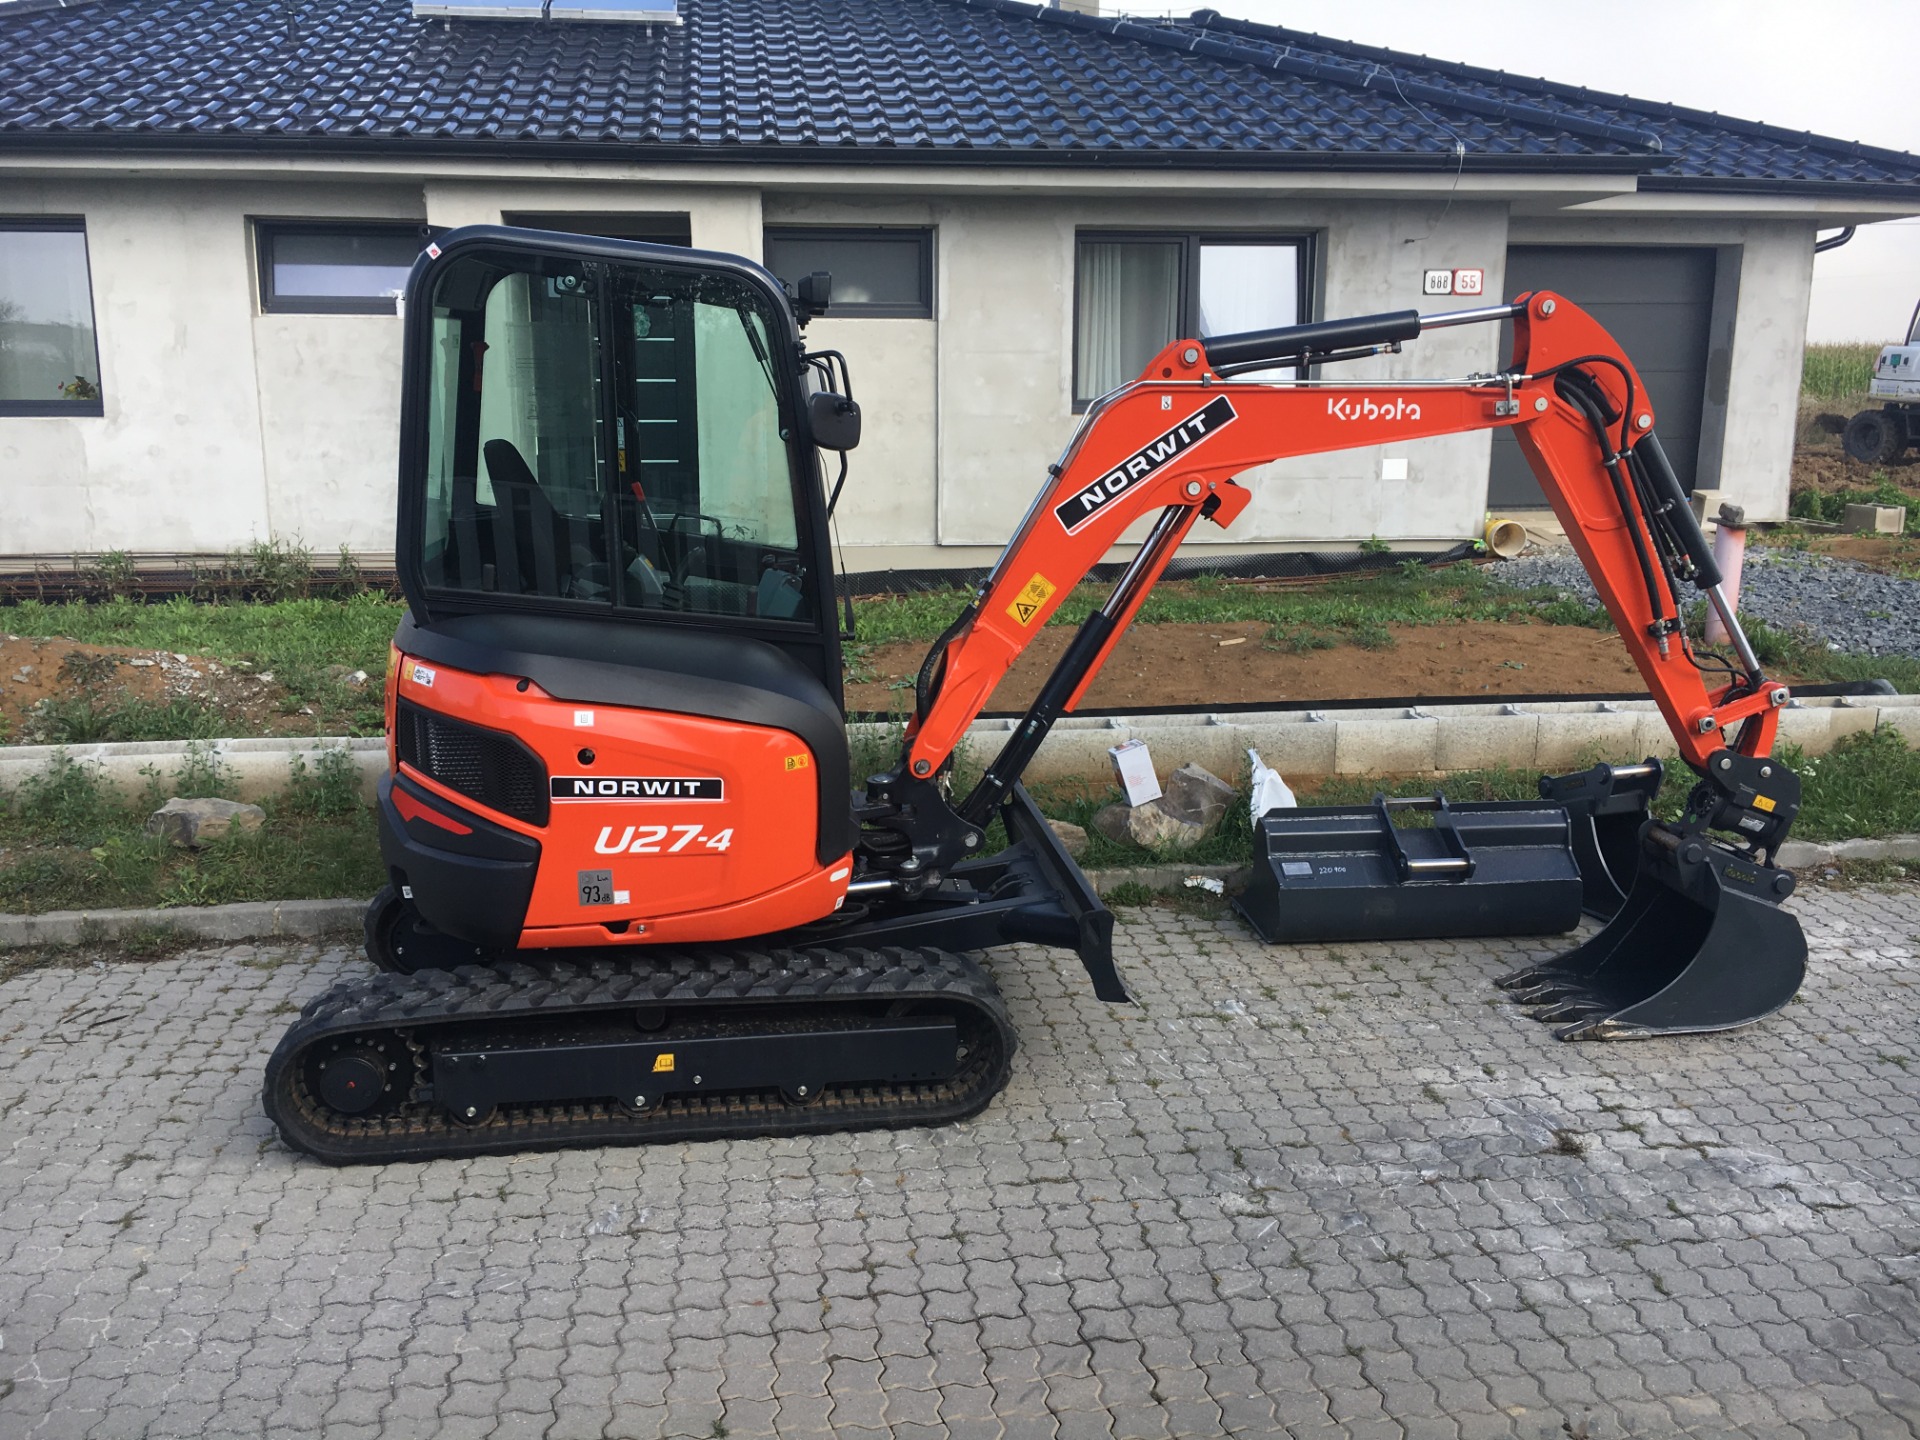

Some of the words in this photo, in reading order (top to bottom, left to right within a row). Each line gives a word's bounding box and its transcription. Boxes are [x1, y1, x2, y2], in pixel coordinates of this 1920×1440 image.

[1461, 274, 1477, 289] 55
[1327, 397, 1421, 420] Kubota
[1080, 413, 1206, 511] NORWIT
[573, 780, 701, 795] NORWIT
[594, 824, 734, 854] U27-4
[1319, 866, 1333, 875] 220
[582, 885, 601, 903] 93
